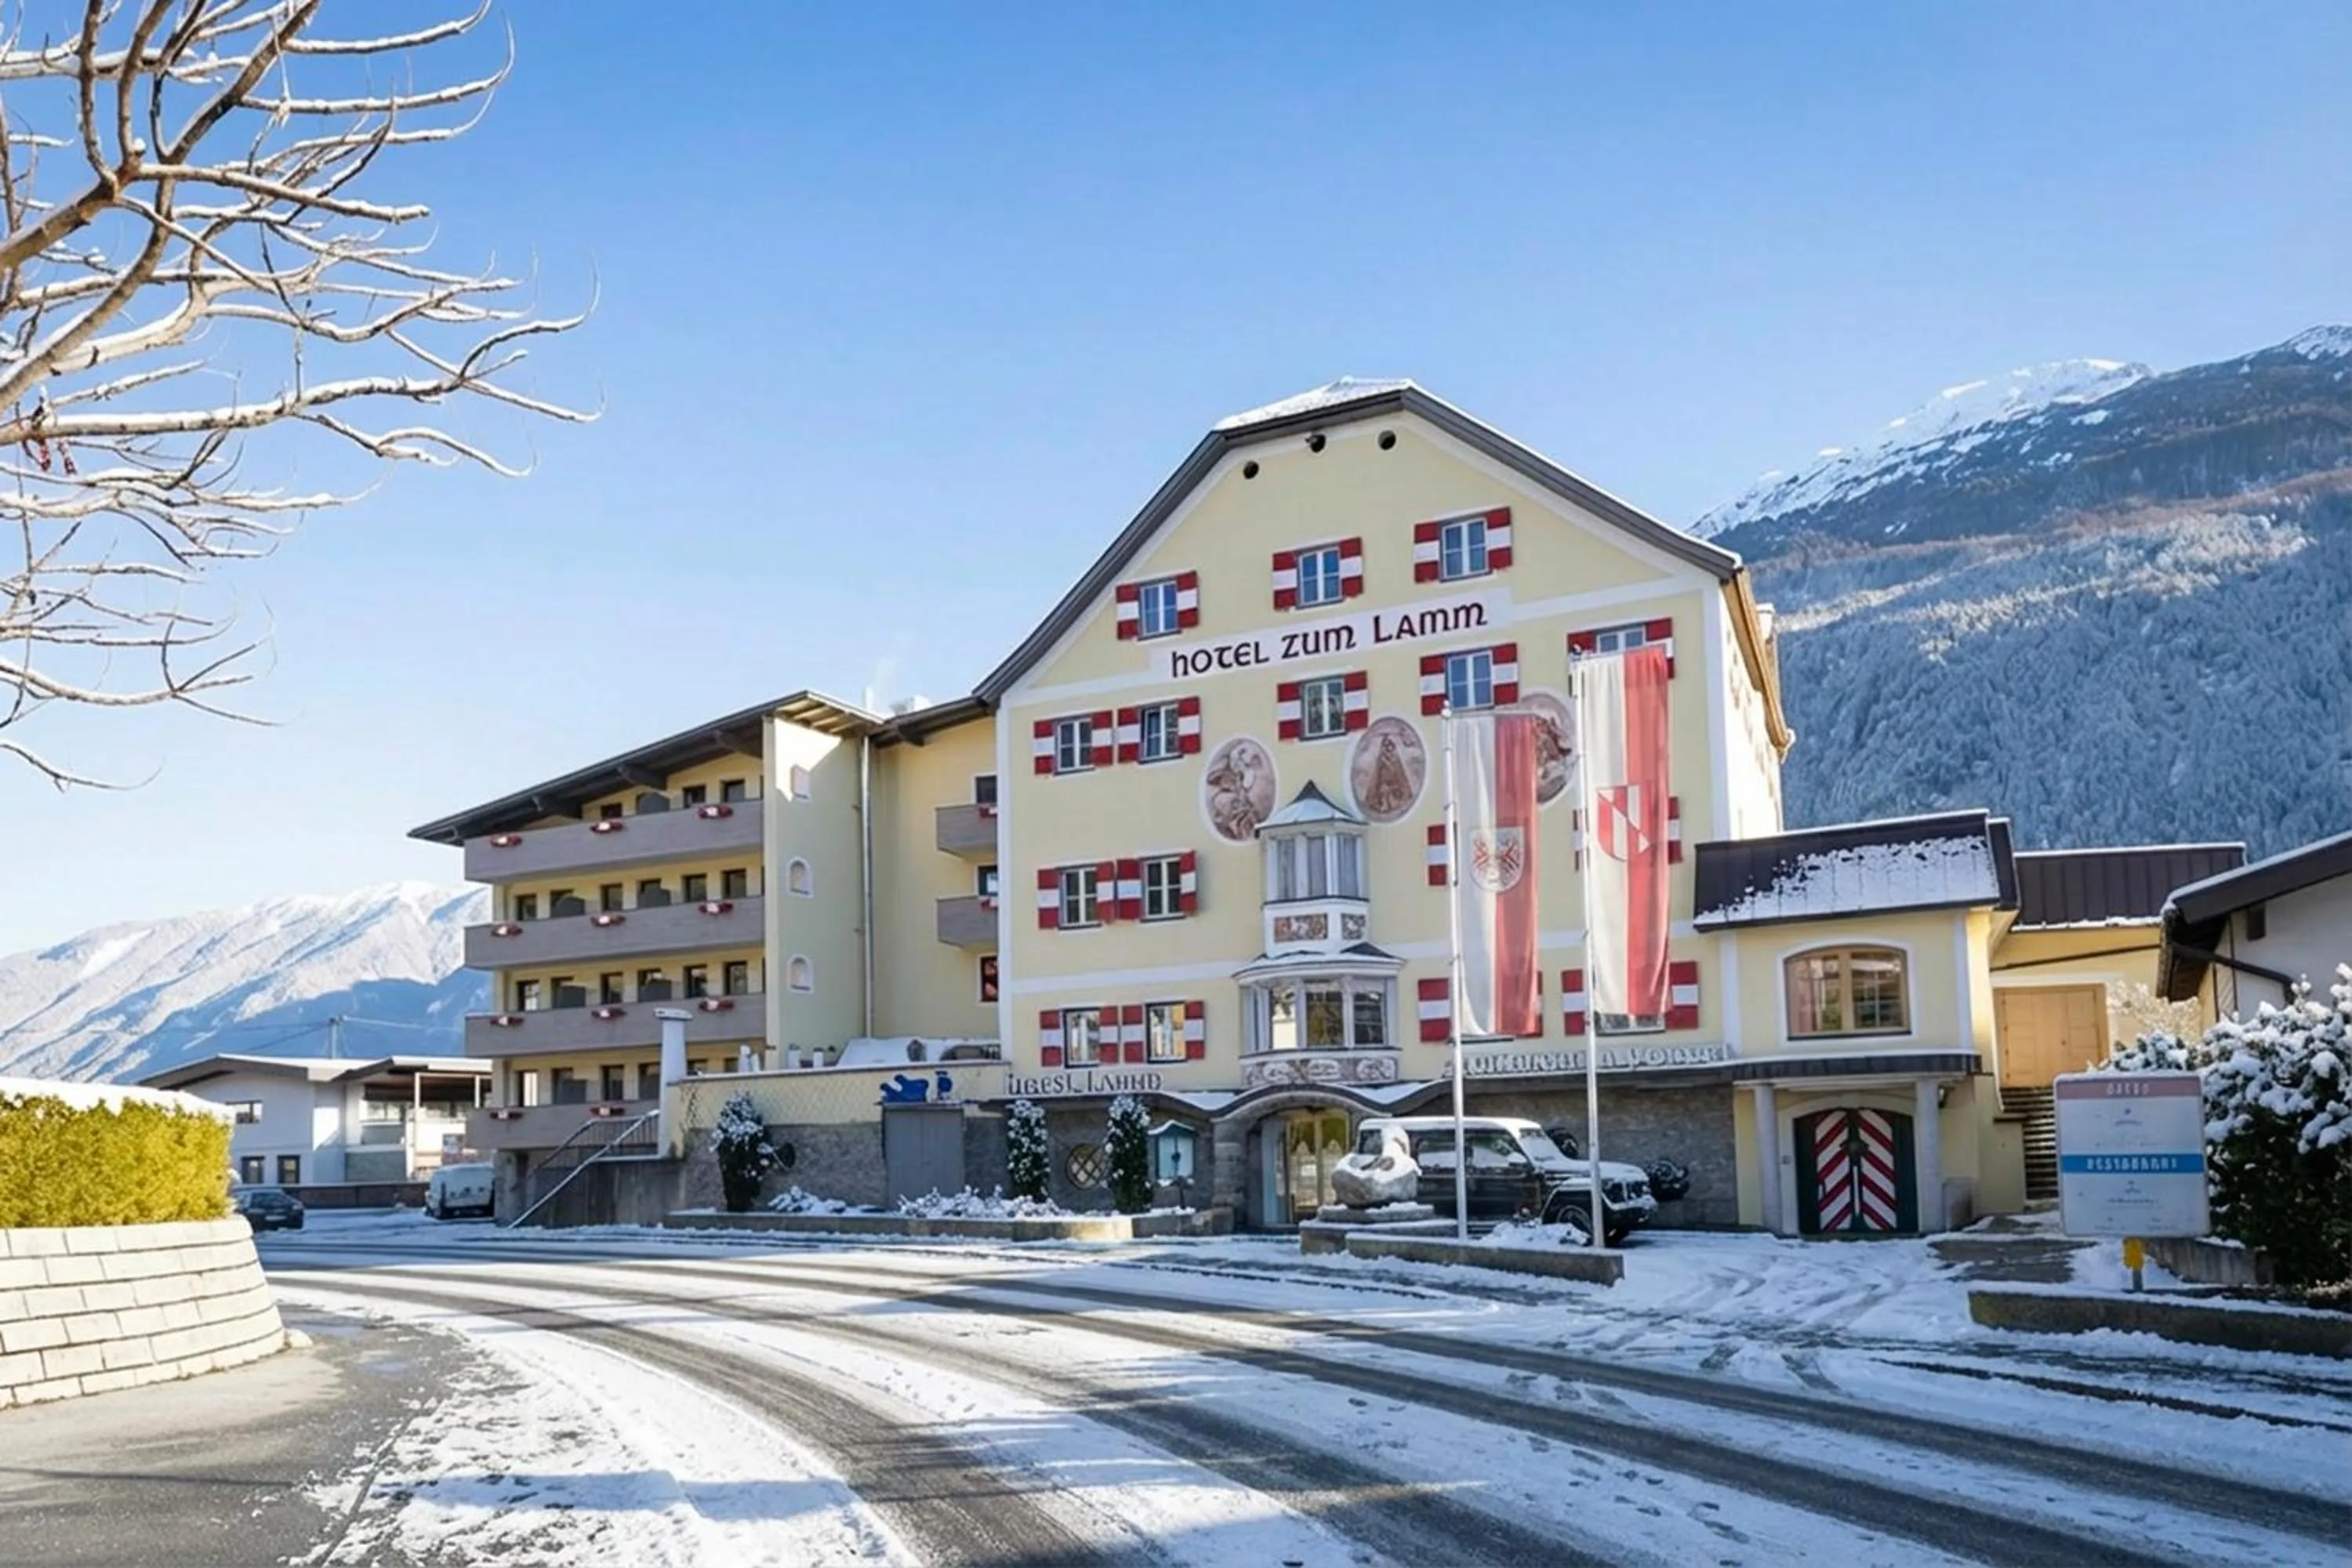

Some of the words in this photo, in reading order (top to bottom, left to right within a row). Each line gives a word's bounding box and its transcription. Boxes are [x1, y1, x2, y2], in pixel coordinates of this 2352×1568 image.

[1171, 641, 1269, 678] HOTEL
[1281, 624, 1356, 659] ZUM
[1373, 601, 1487, 644] LAMM
